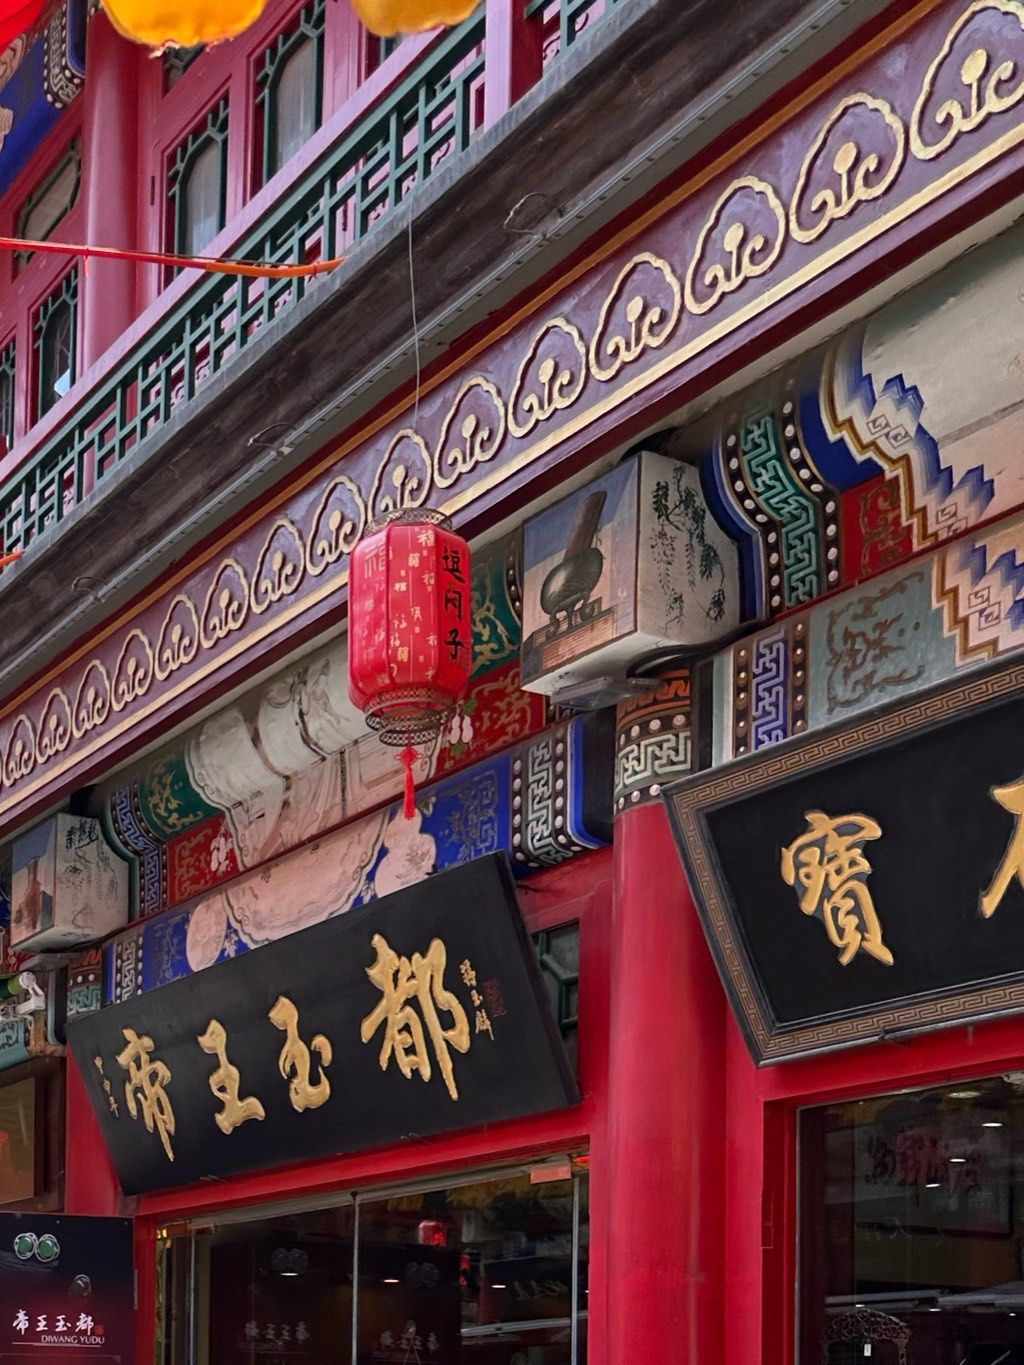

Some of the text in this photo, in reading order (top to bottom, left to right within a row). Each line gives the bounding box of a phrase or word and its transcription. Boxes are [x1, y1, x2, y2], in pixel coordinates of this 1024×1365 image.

[115, 932, 471, 1162] 帝王玉都
[12, 1308, 95, 1336] 帝王玉都
[41, 1333, 105, 1345] DIWANG YUDU
